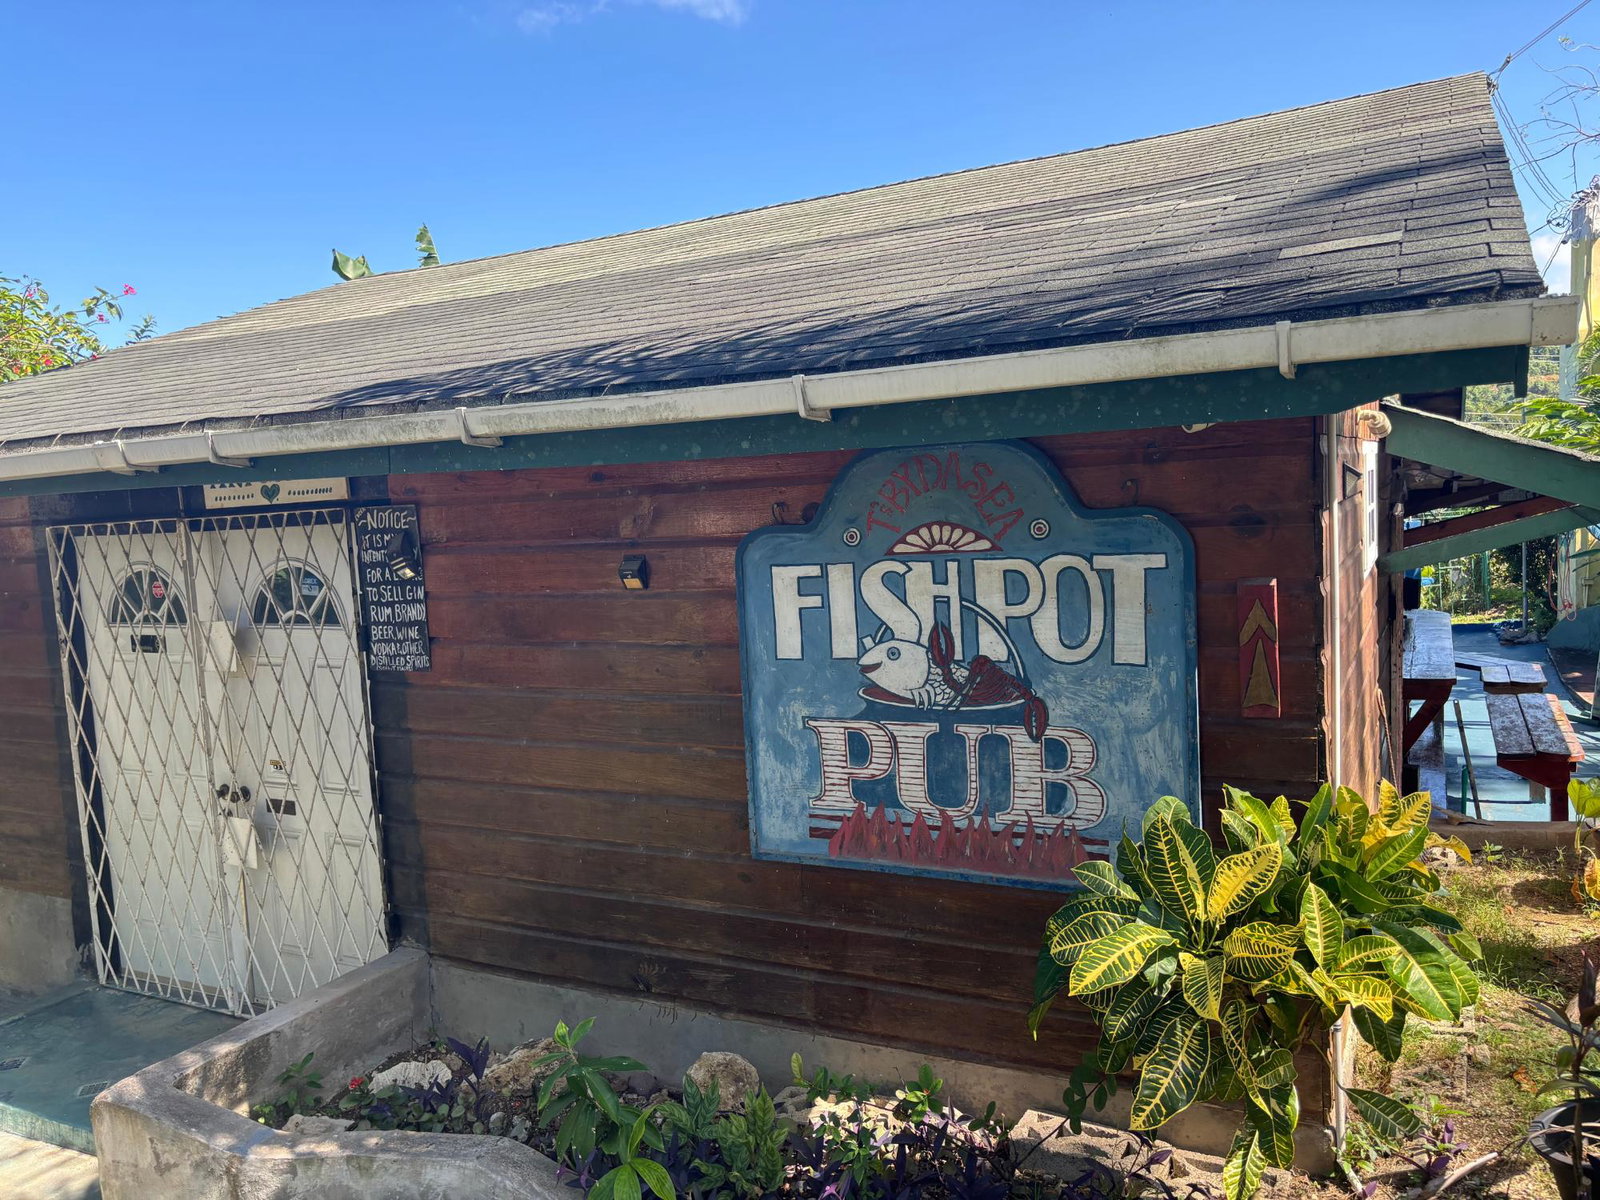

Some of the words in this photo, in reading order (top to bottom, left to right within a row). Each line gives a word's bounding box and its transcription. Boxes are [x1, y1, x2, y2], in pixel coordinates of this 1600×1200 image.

[362, 533, 371, 550] IT
[373, 534, 382, 547] IS
[384, 533, 397, 547] M
[367, 567, 383, 583] FOR
[385, 567, 392, 582] A
[366, 587, 378, 602] TO
[380, 586, 404, 603] SELL
[406, 585, 425, 600] GIN
[396, 626, 420, 641] WINE
[370, 642, 397, 656] VODKA
[402, 640, 425, 656] OTHER
[406, 655, 430, 668] SPIRITS
[805, 717, 1108, 830] PUB
